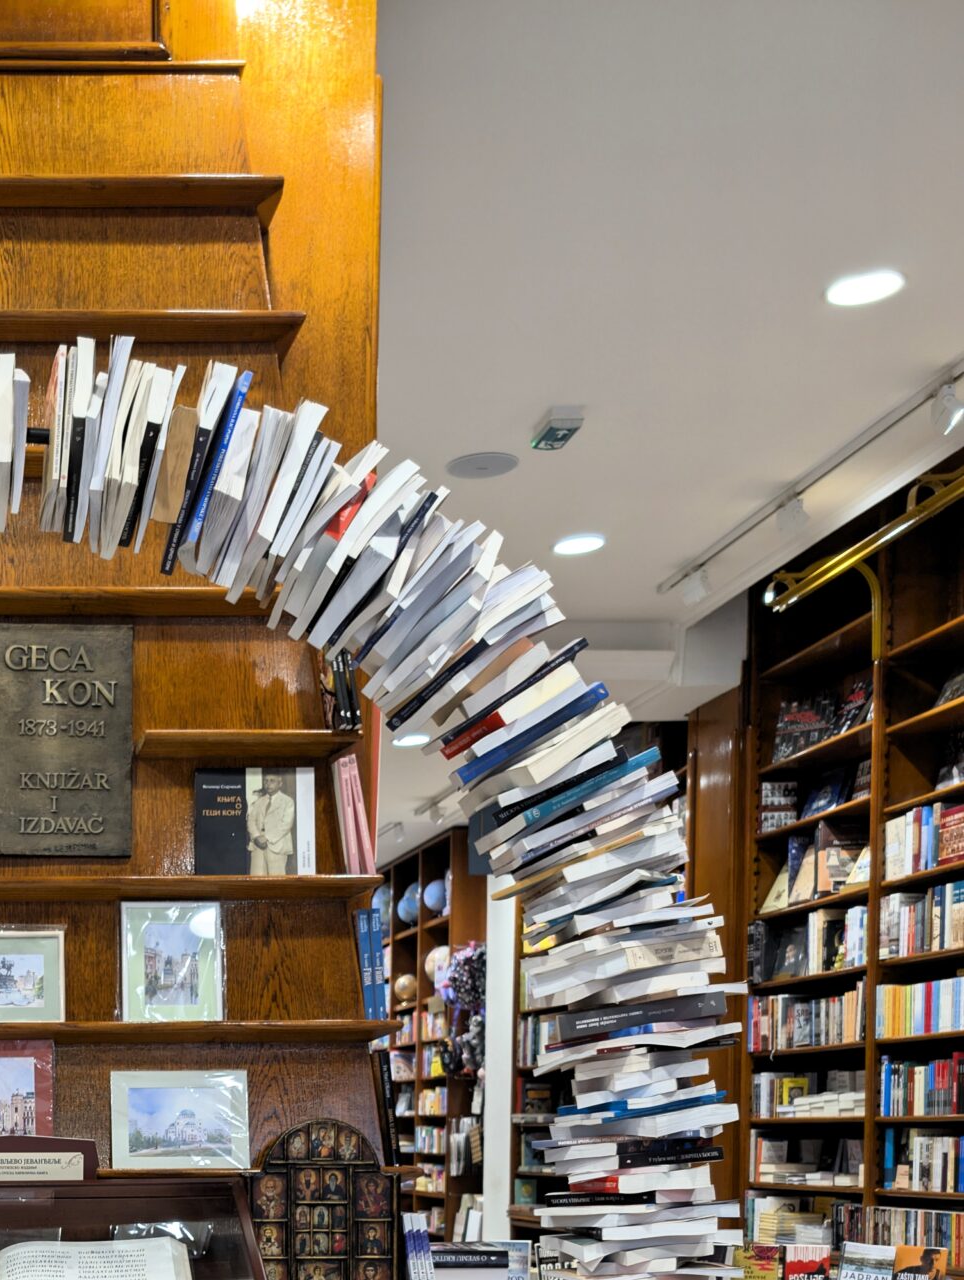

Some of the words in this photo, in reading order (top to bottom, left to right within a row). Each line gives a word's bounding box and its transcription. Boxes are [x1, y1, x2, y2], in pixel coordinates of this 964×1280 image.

[4, 644, 94, 672] GECA
[42, 678, 118, 707] KON
[20, 769, 110, 790] KNJIŽAR
[50, 795, 58, 813] I
[19, 813, 104, 834] IZDAVAČ
[433, 1254, 456, 1262] KRITIČ
[457, 1254, 481, 1262] SVEMU
[897, 1272, 914, 1280] ZAŠTO
[915, 1273, 929, 1280] TAKO
